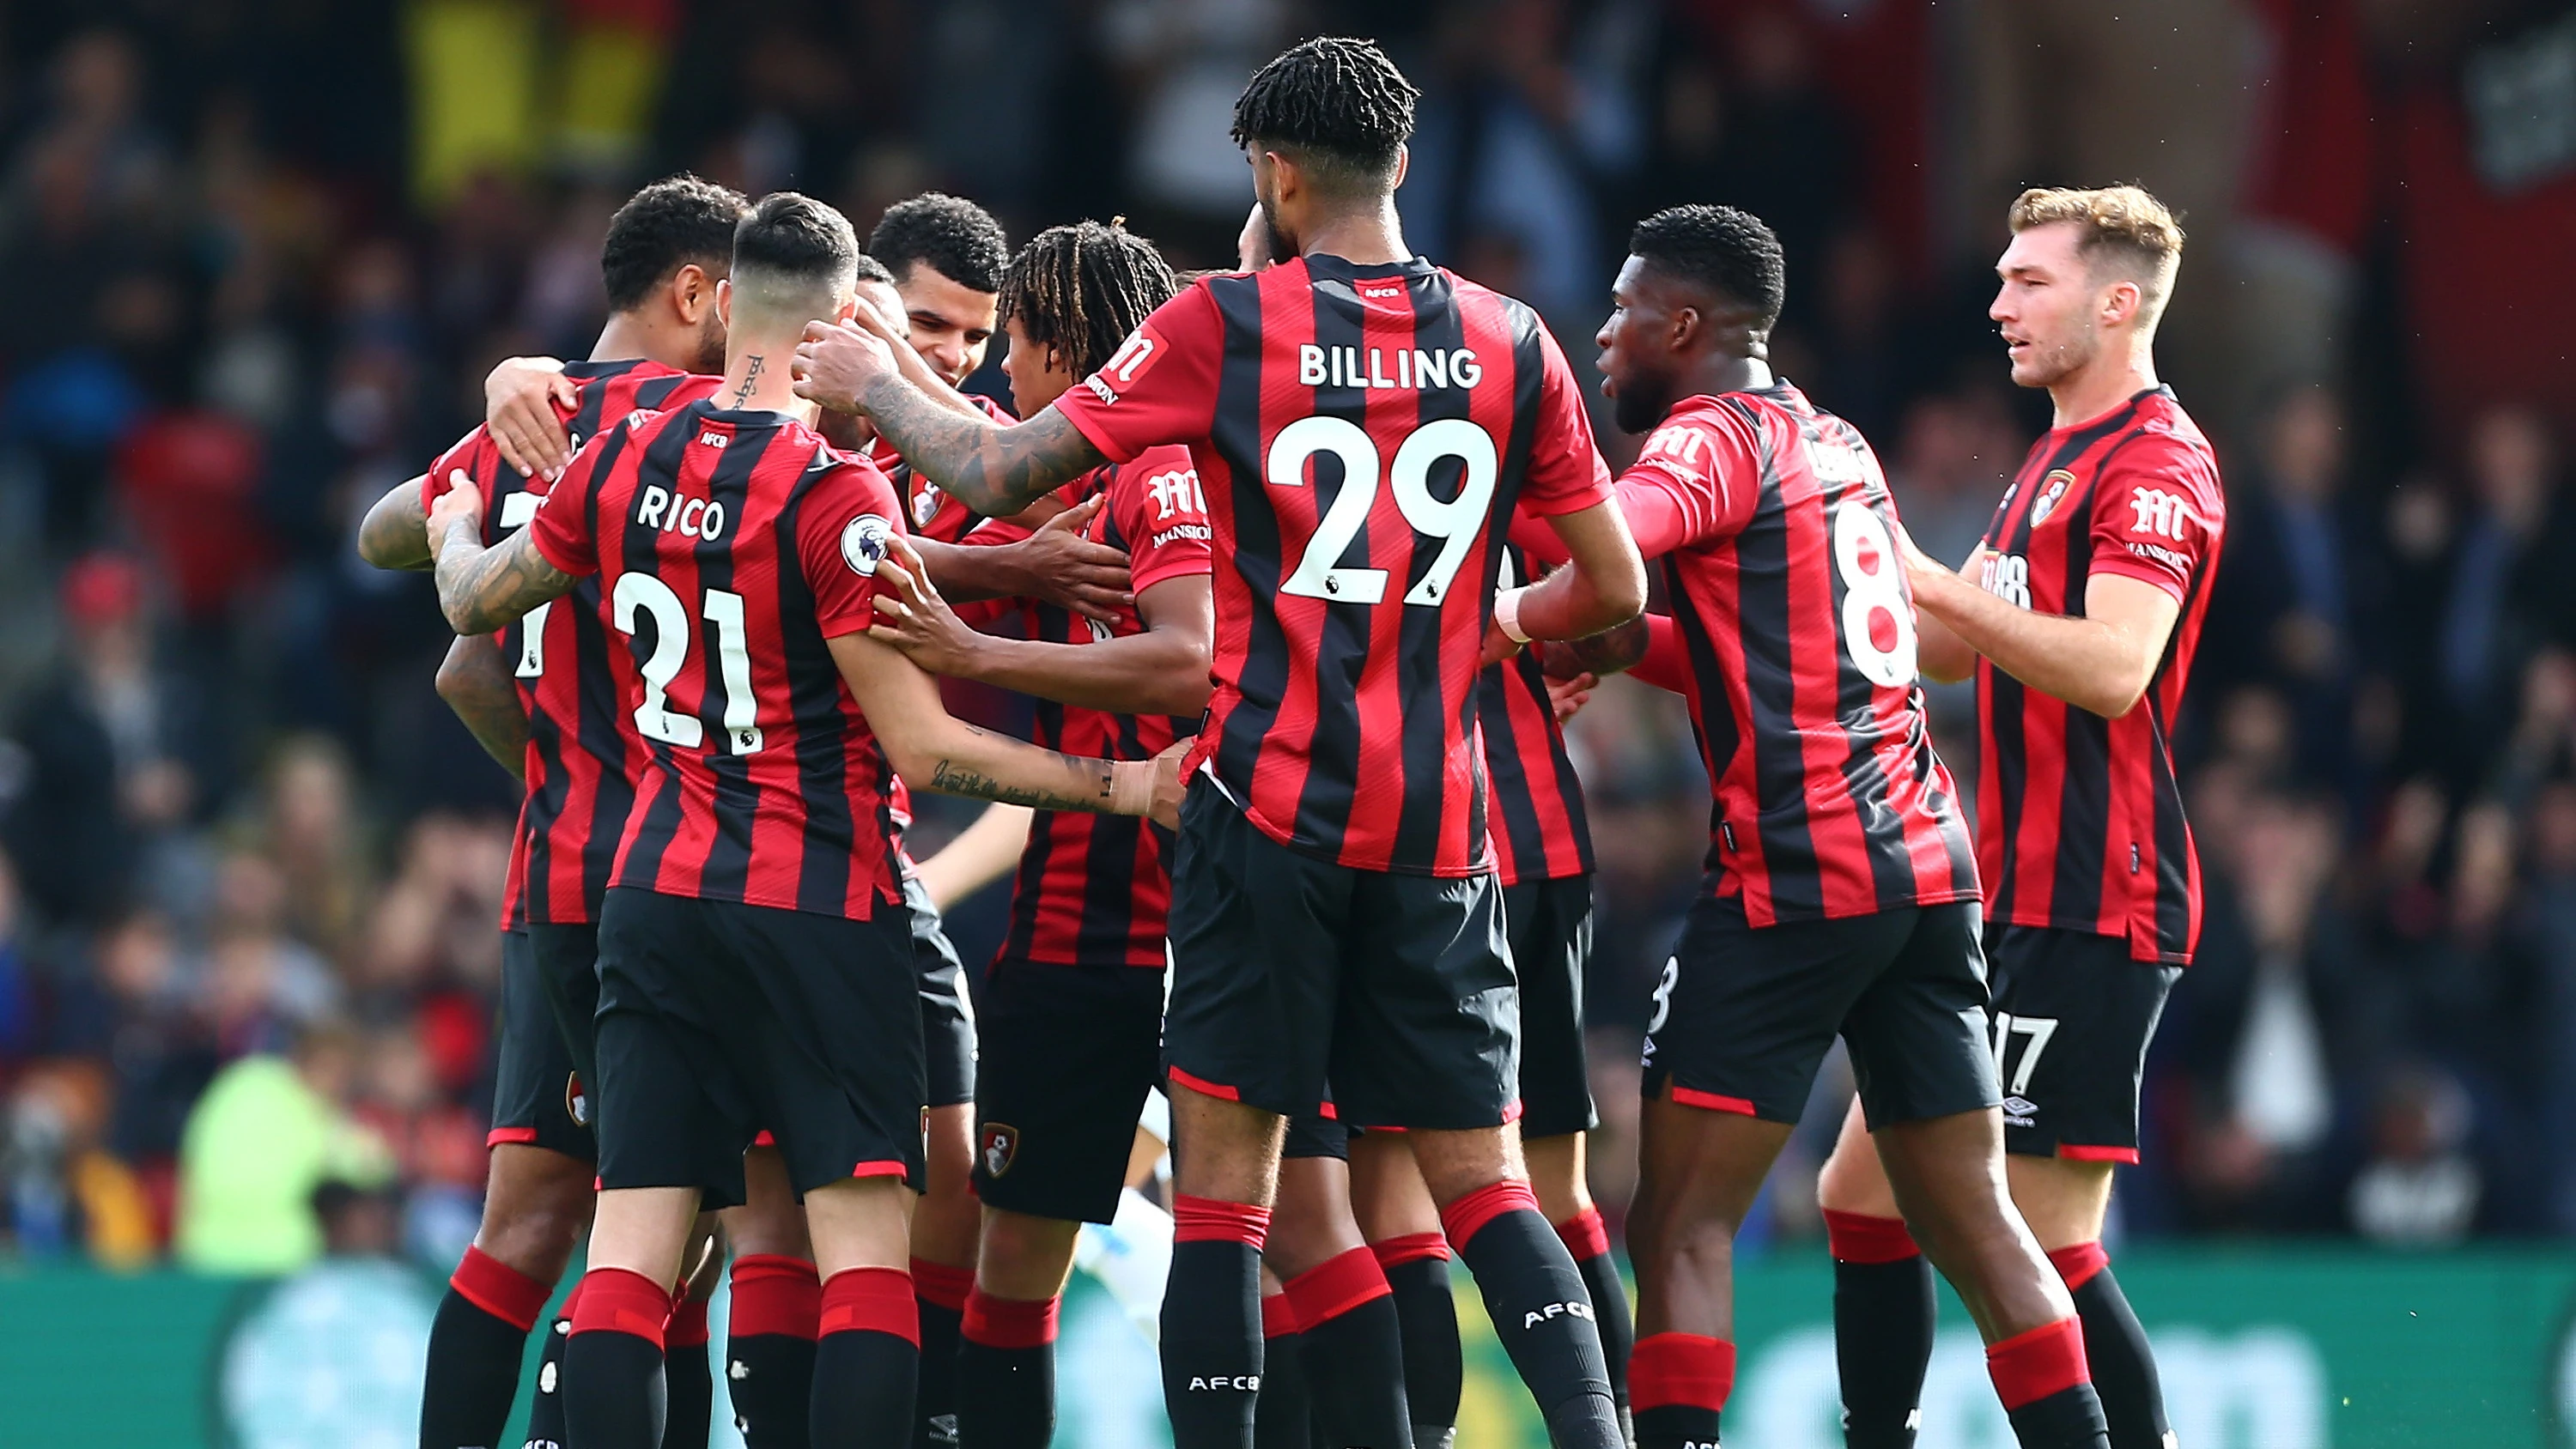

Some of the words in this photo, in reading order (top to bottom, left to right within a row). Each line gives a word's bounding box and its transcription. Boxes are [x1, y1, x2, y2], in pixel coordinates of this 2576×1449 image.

[1299, 343, 1482, 389] BILLING
[700, 432, 728, 448] AFCB
[637, 484, 725, 542] RICO
[1267, 416, 1498, 607] 29
[1834, 500, 1917, 688] 8
[612, 571, 763, 756] 21
[1993, 1010, 2060, 1096] 17
[1188, 1376, 1261, 1391] AFCB
